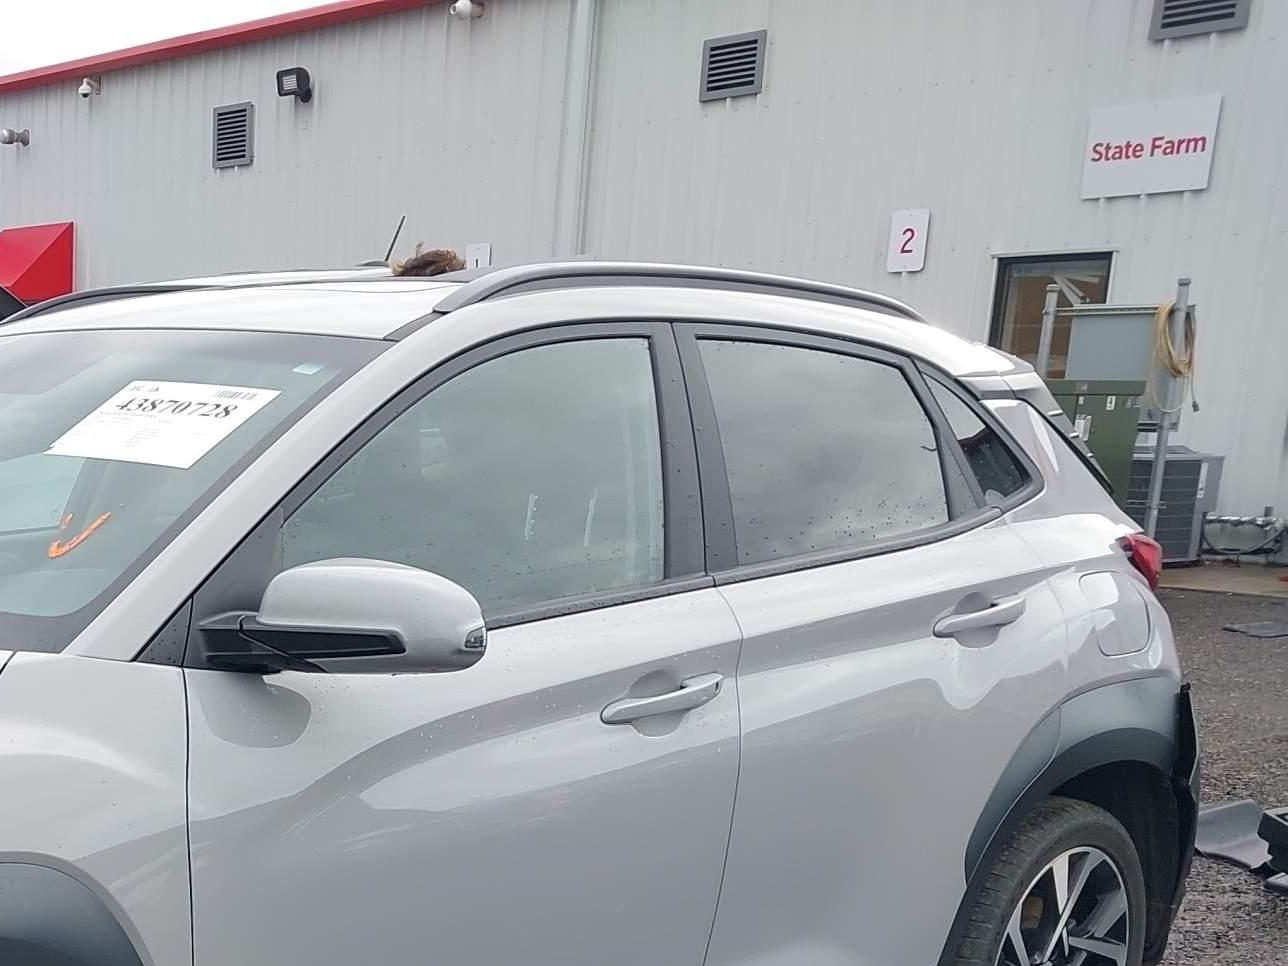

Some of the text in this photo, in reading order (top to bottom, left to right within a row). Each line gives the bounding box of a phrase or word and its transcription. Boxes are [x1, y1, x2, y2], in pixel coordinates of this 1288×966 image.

[1091, 136, 1207, 162] State Farm
[899, 227, 916, 254] 2
[116, 397, 238, 418] 43870728
